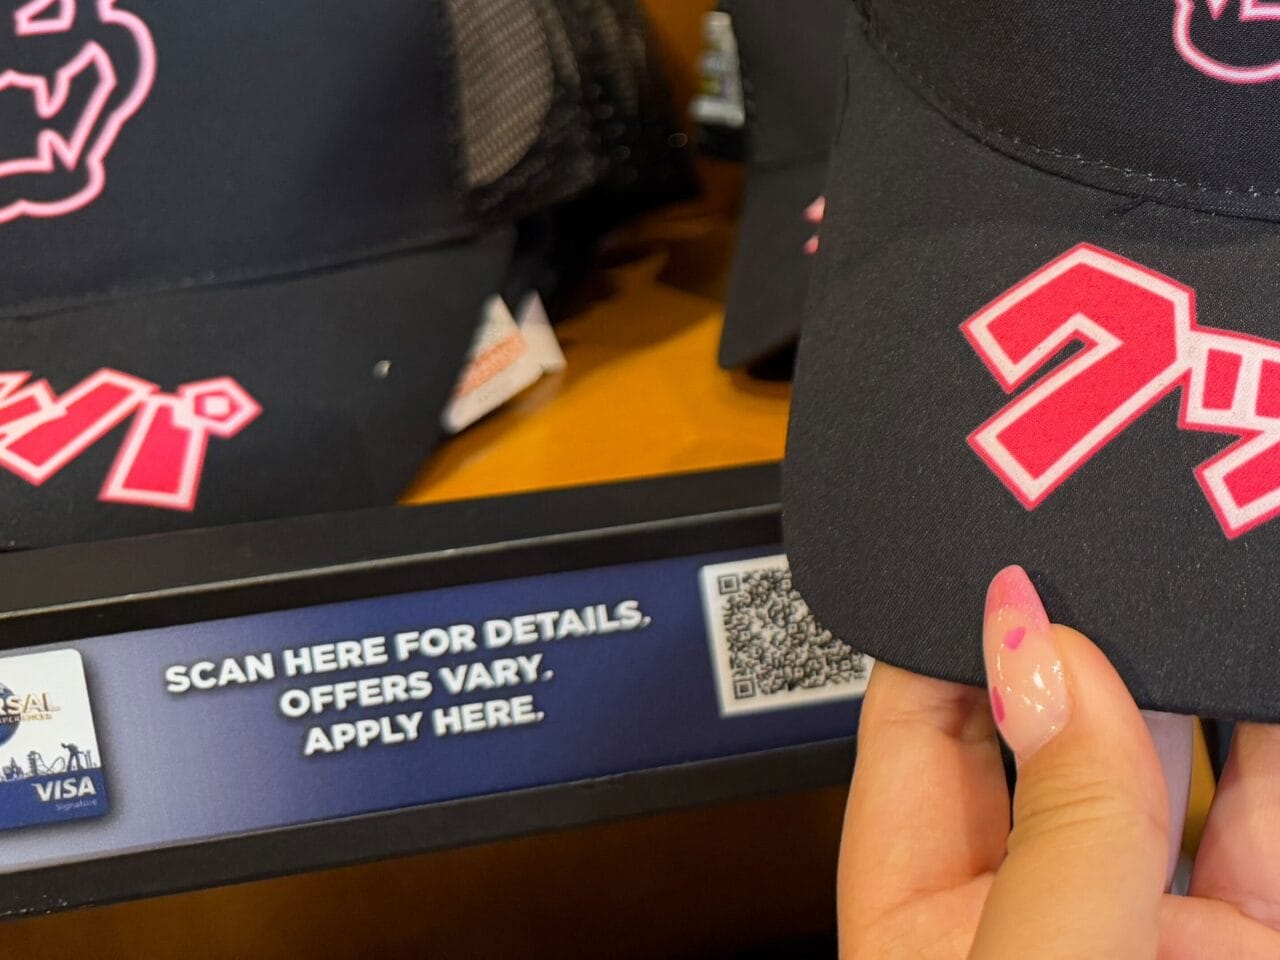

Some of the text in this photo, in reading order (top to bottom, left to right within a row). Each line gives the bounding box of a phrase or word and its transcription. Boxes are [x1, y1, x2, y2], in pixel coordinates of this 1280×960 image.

[165, 600, 651, 693] SCAN HERE FOR DETAILS.
[280, 653, 553, 717] OFFERS VARY.
[304, 695, 544, 756] APPLY HERE.
[31, 776, 96, 802] VISA
